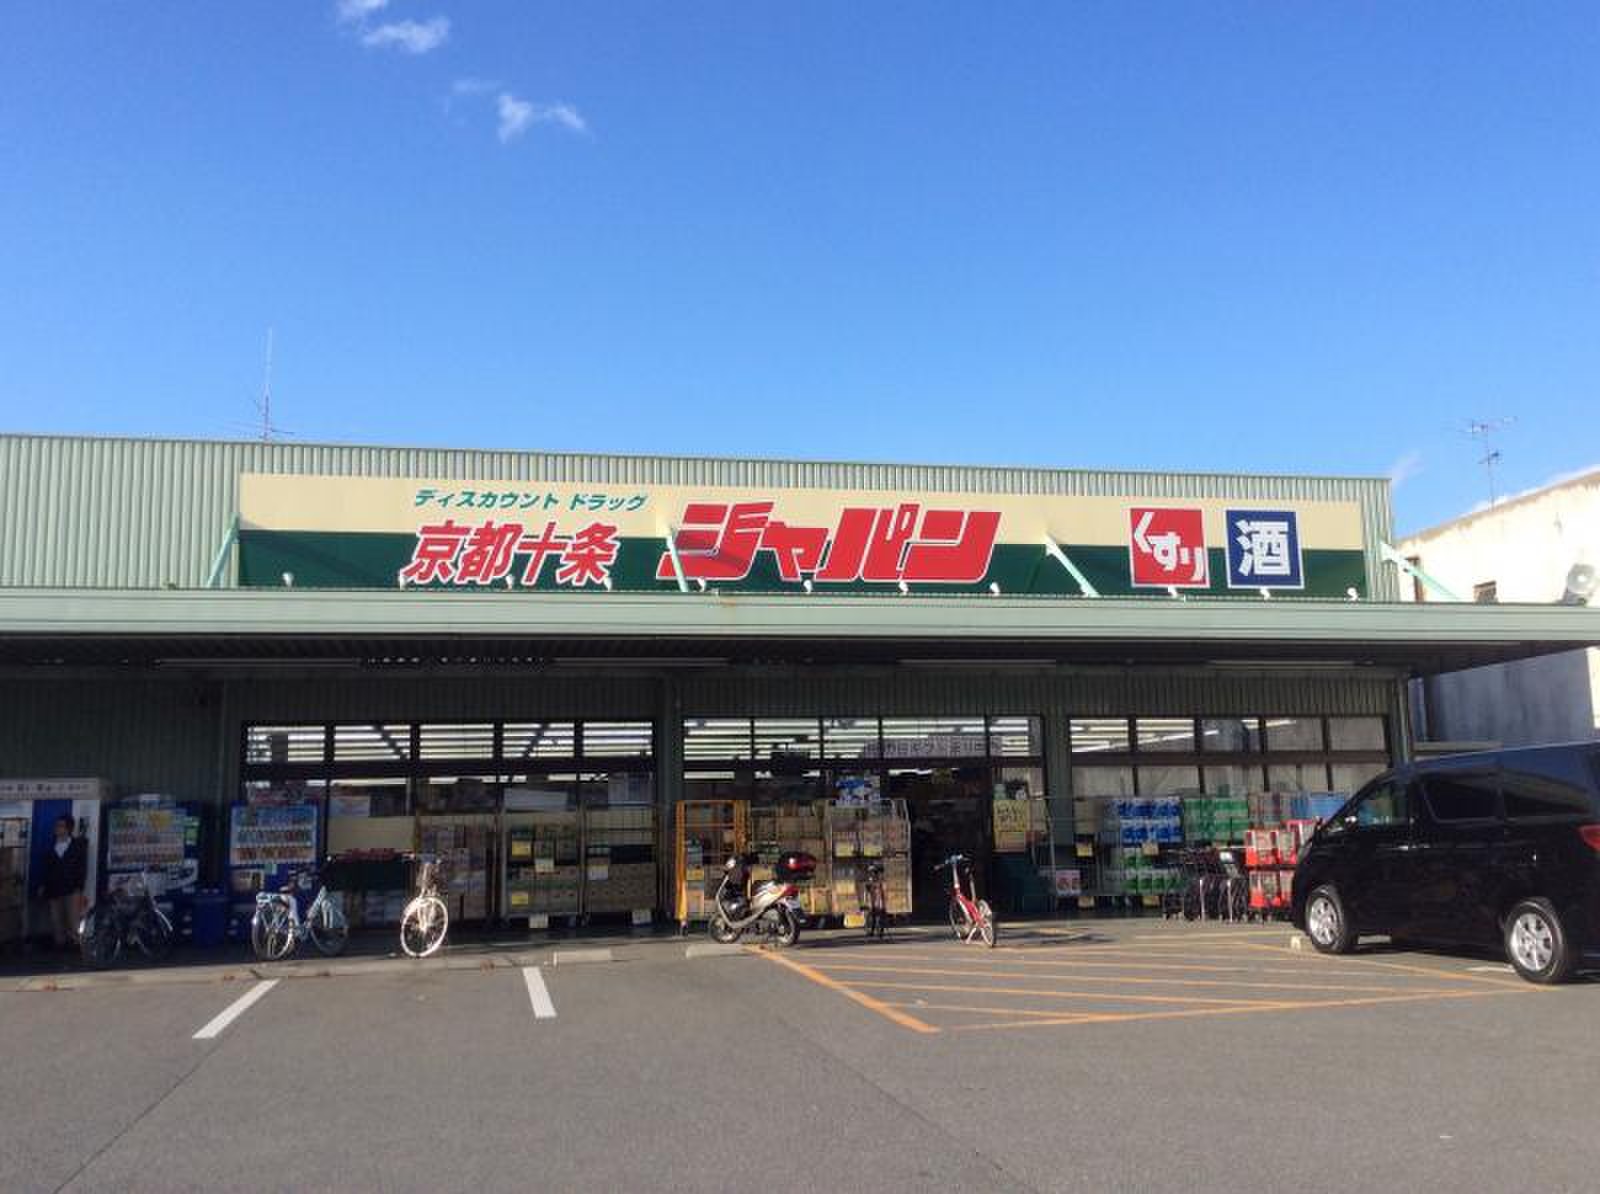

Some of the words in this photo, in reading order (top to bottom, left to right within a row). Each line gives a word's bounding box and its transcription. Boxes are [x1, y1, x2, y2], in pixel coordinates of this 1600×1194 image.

[415, 488, 559, 510] ディスカウント
[569, 493, 648, 511] ドラッグ
[402, 519, 620, 586] 京都十条
[655, 500, 1002, 583] ジャパン
[1133, 511, 1205, 581] くすり
[1236, 519, 1291, 576] 酒
